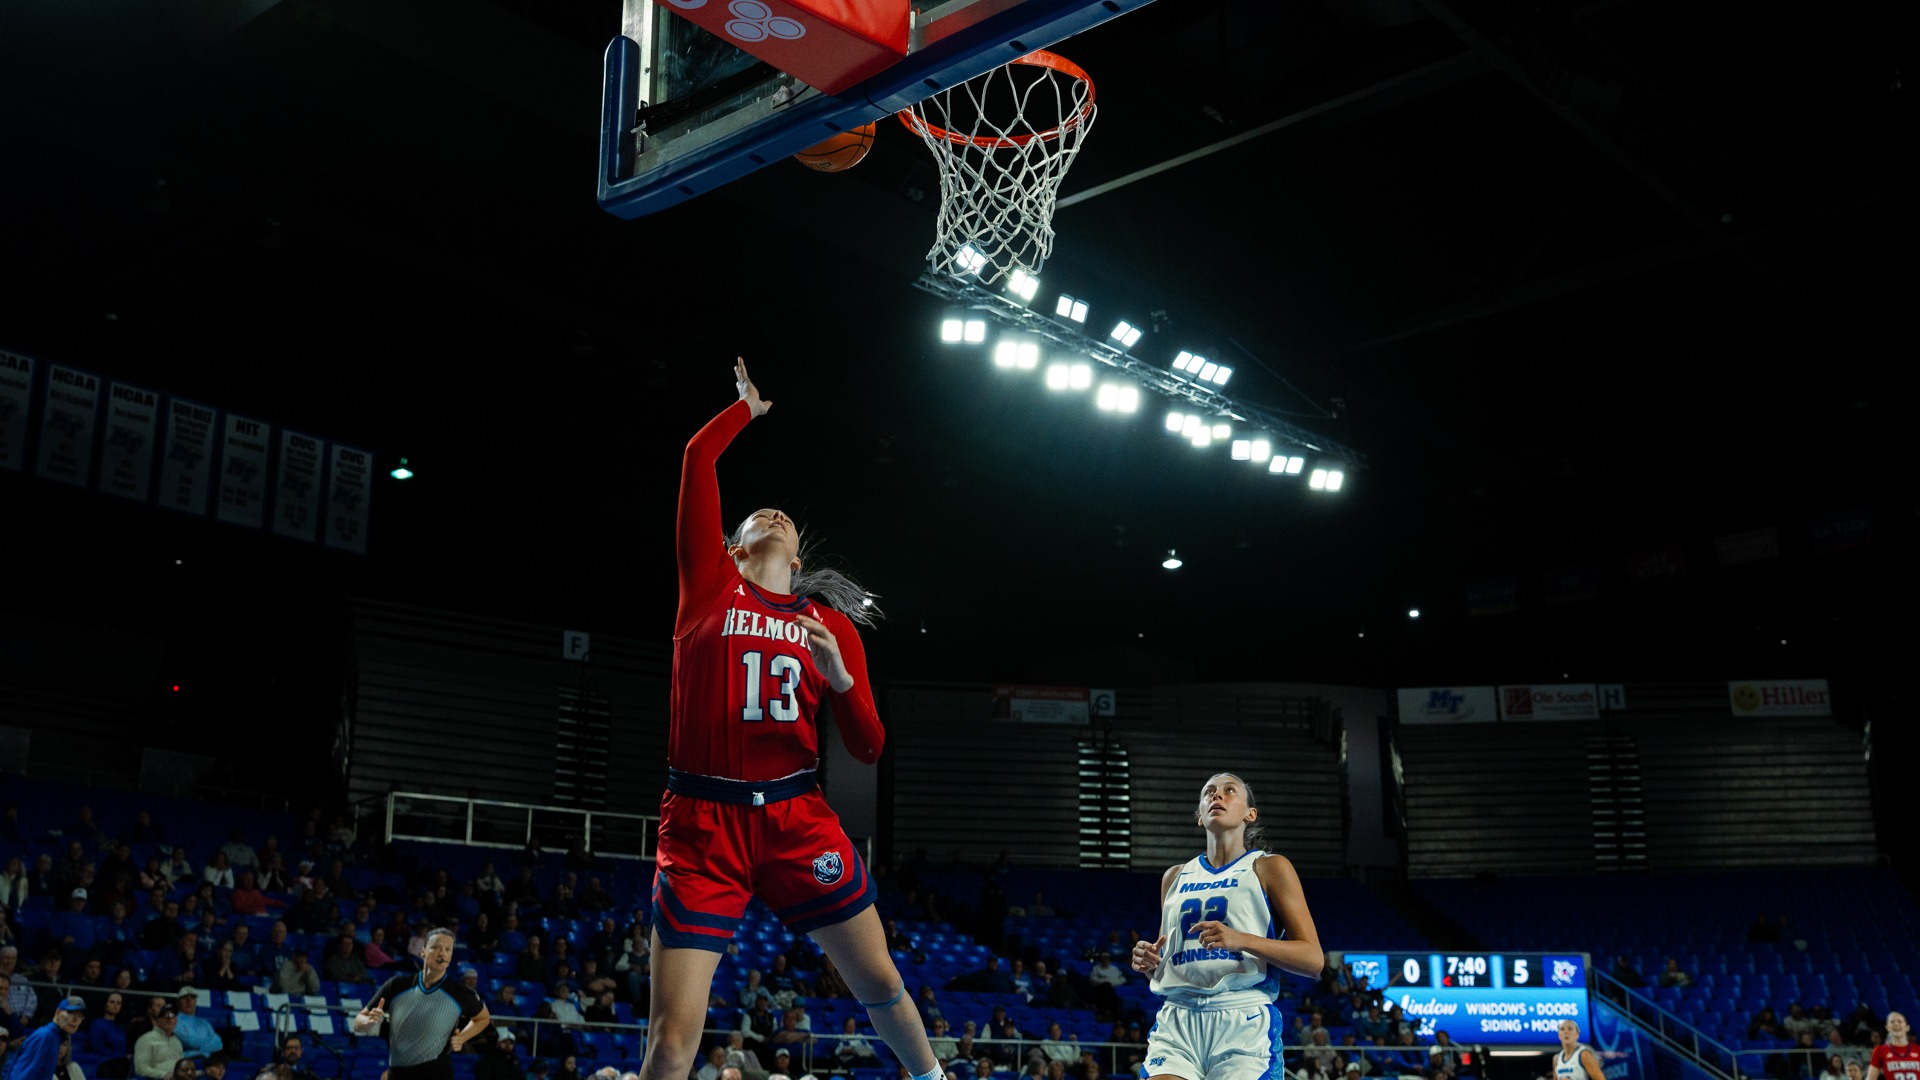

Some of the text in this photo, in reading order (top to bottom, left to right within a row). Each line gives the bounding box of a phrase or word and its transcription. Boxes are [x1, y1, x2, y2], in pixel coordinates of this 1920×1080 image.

[0, 353, 29, 373] CAA
[52, 368, 96, 391] NCAA
[112, 386, 154, 407] NCAA
[236, 419, 260, 437] NIT
[290, 435, 316, 451] OVC
[340, 449, 365, 465] OVC
[721, 607, 811, 651] BELMON
[570, 636, 582, 655] F
[741, 650, 804, 723] 13
[1096, 694, 1111, 710] G
[1428, 690, 1465, 713] MT
[1533, 690, 1593, 704] Ole South
[1604, 689, 1619, 705] H
[1761, 687, 1827, 705] Hiller
[1179, 877, 1239, 894] MIDDLE
[1180, 896, 1229, 941] 22
[1403, 958, 1421, 984] 0
[1447, 956, 1487, 976] 7:40
[1513, 959, 1529, 984] 5
[1458, 975, 1475, 987] 1ST
[1465, 1002, 1579, 1016] WINDOWS DOORS
[1480, 1018, 1522, 1032] SIDING
